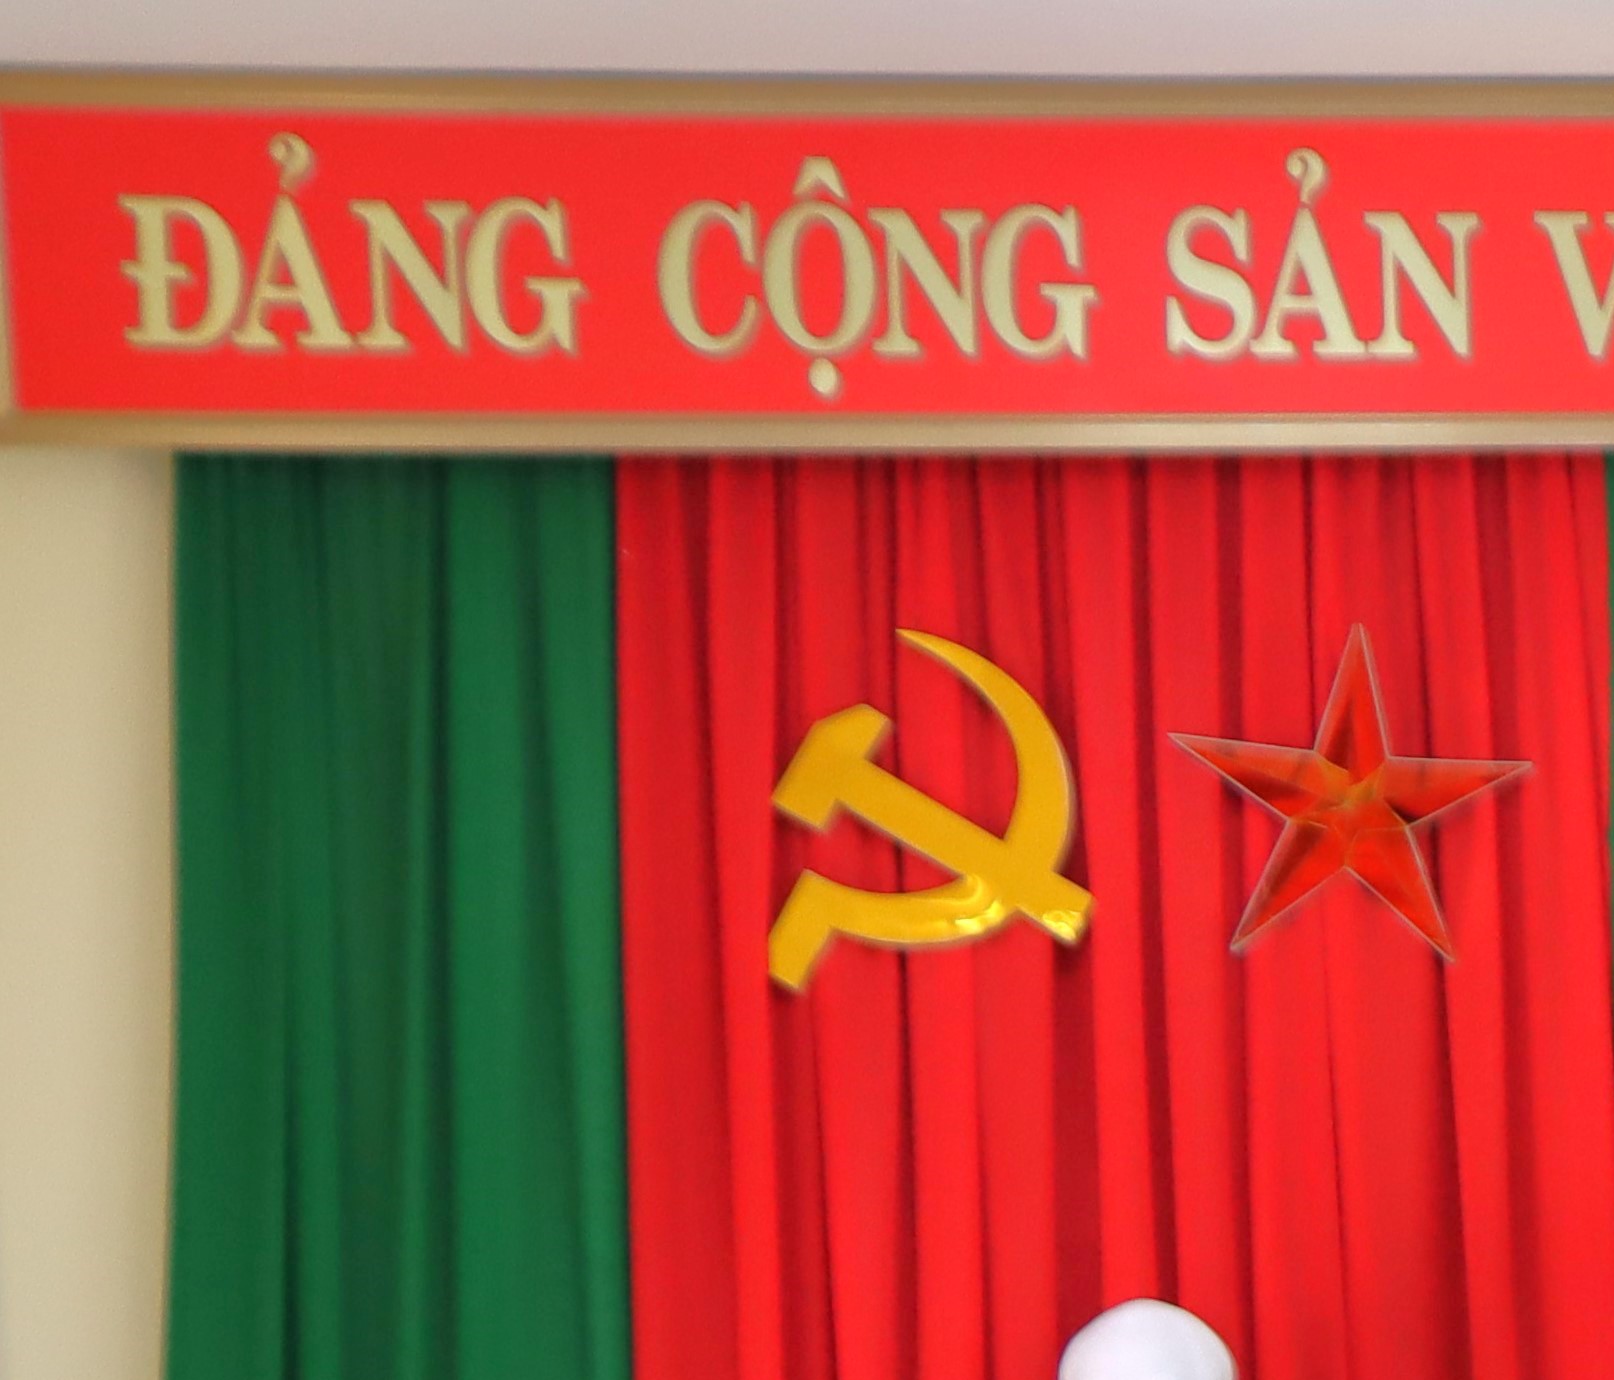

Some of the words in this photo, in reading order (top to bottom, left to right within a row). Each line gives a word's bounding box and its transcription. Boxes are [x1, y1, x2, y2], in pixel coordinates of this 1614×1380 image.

[119, 133, 584, 356] ĐẢNG
[657, 156, 1097, 395] CỘNG
[1165, 148, 1480, 362] SẢN
